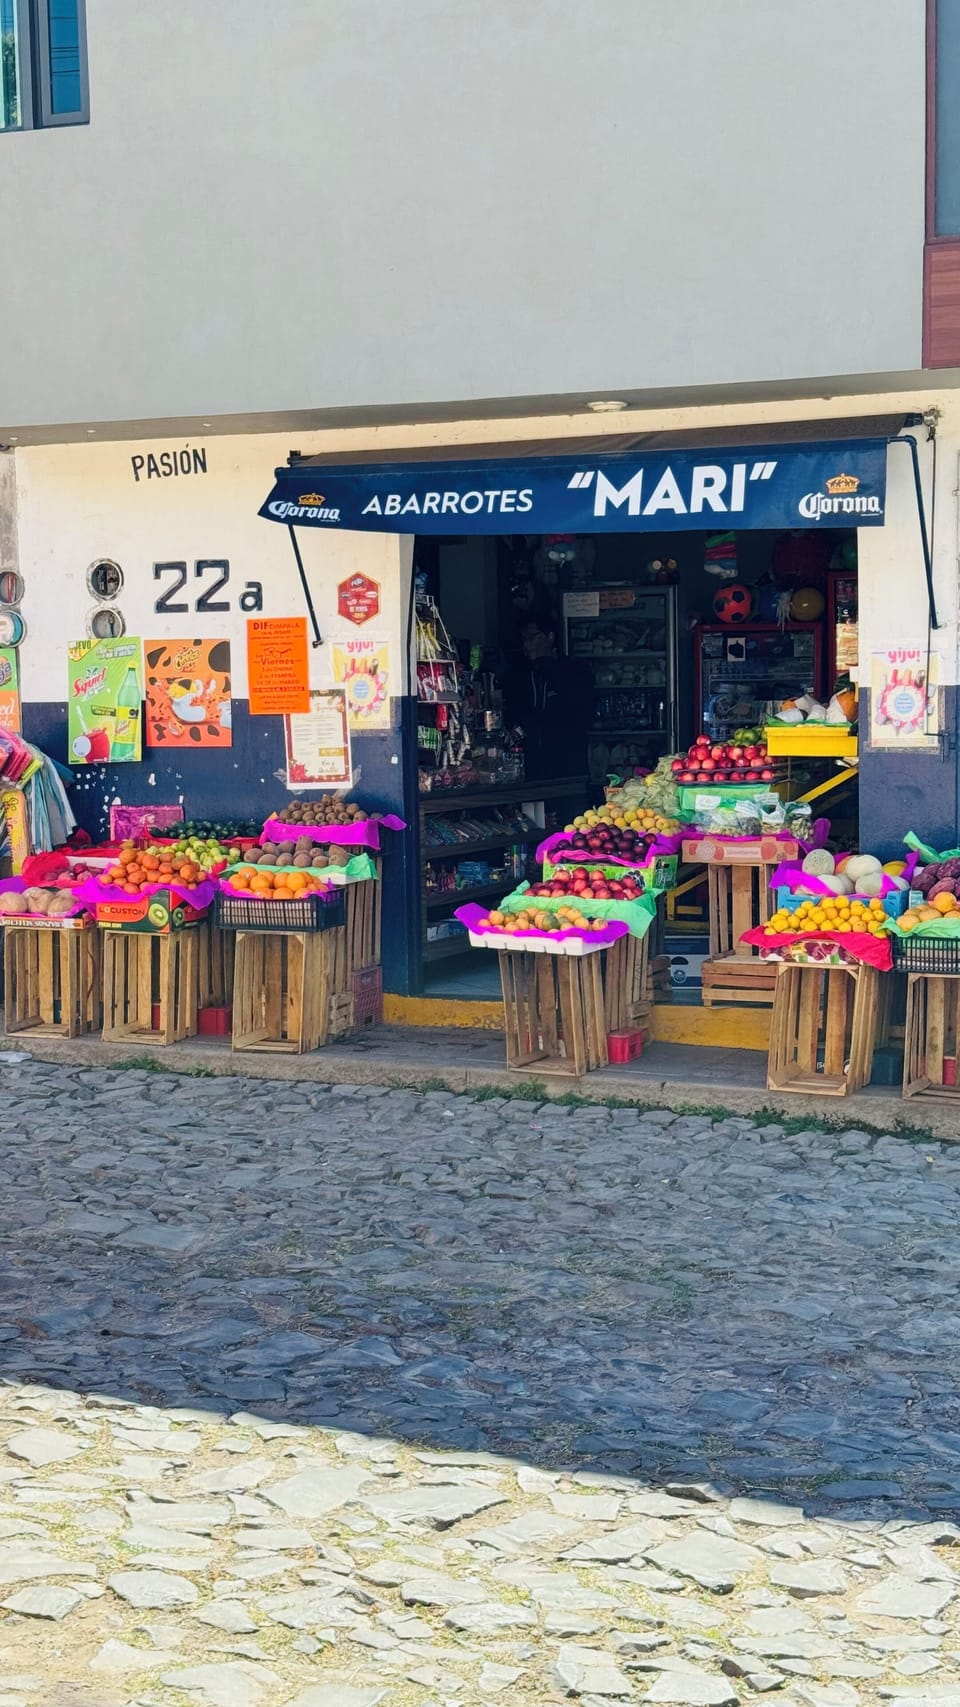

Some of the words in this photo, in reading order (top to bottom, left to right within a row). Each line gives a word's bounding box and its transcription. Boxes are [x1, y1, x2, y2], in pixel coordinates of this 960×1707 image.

[131, 443, 207, 482] PASIÓN
[361, 488, 533, 516] ABARROTES
[566, 461, 778, 517] "MARI"
[268, 501, 341, 520] Corona
[798, 491, 882, 521] Corona
[253, 621, 268, 630] DIF
